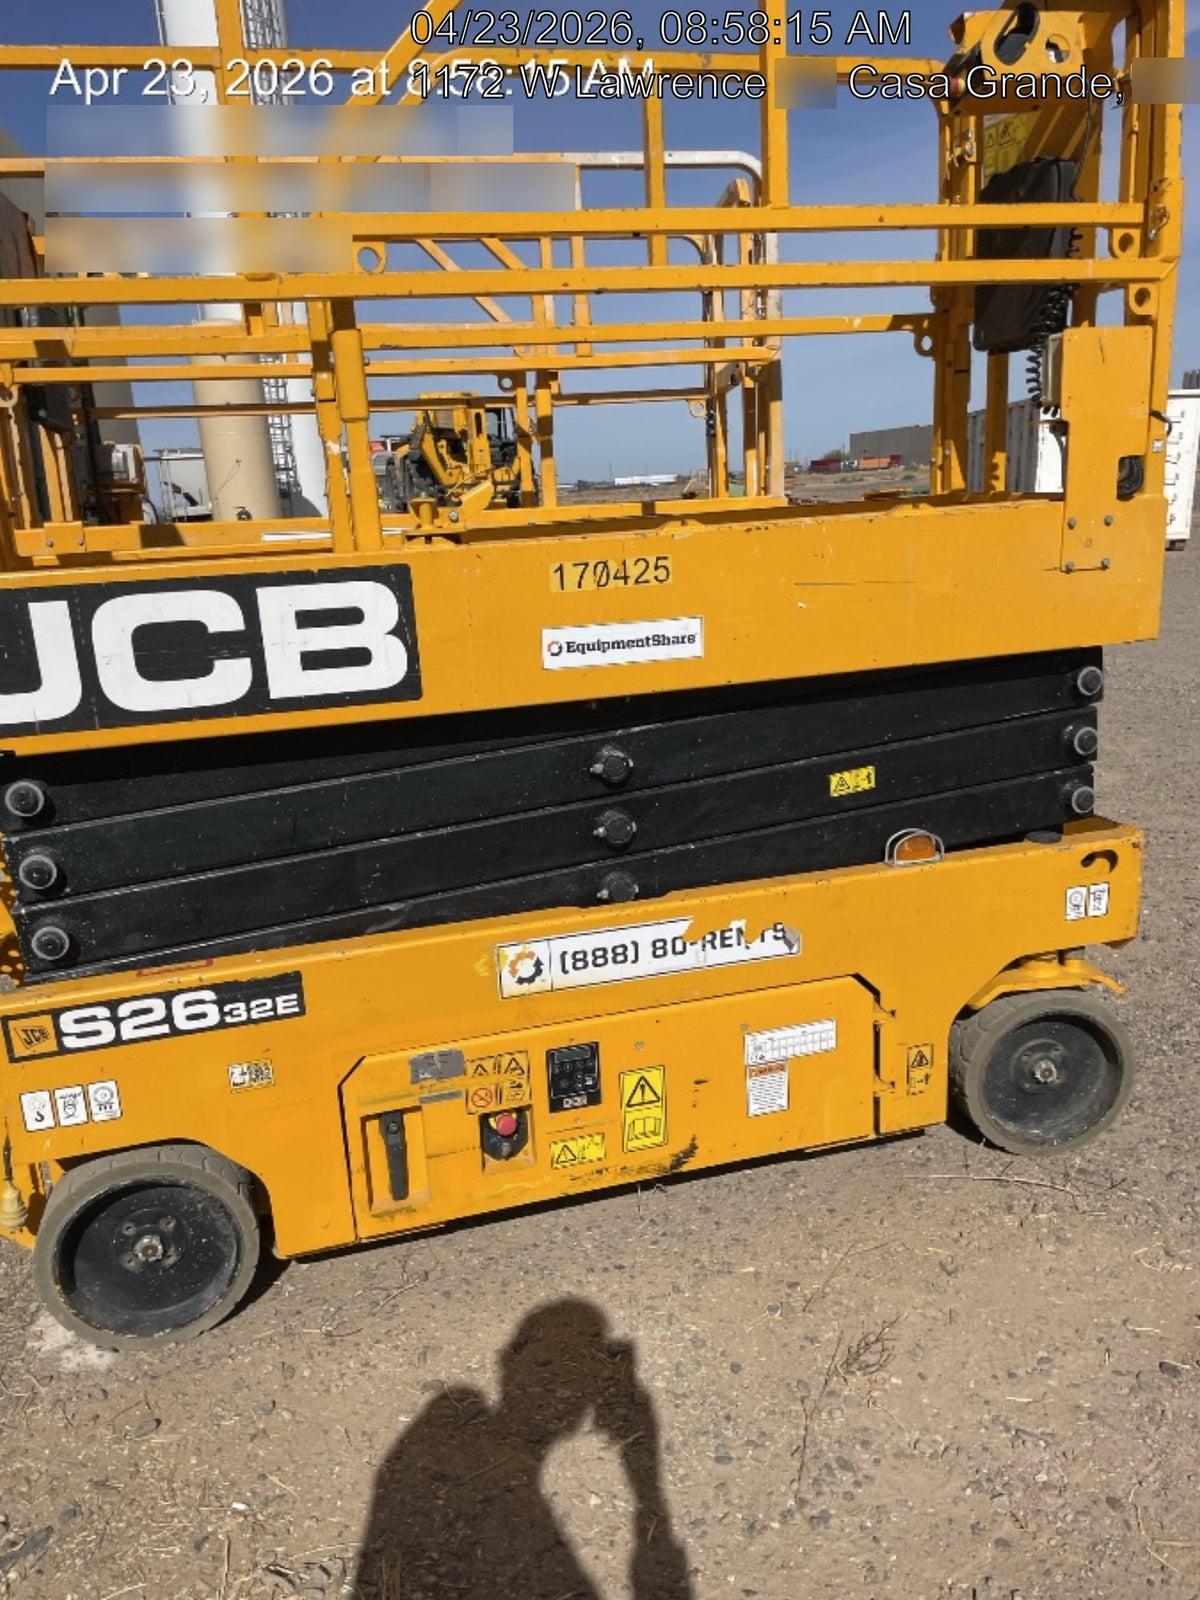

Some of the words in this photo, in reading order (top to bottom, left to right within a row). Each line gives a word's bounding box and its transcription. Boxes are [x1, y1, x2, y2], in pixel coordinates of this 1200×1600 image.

[554, 556, 670, 590] 170425
[0, 580, 408, 725] JCB
[565, 633, 696, 654] EquipmentShare
[559, 940, 640, 974] (888)
